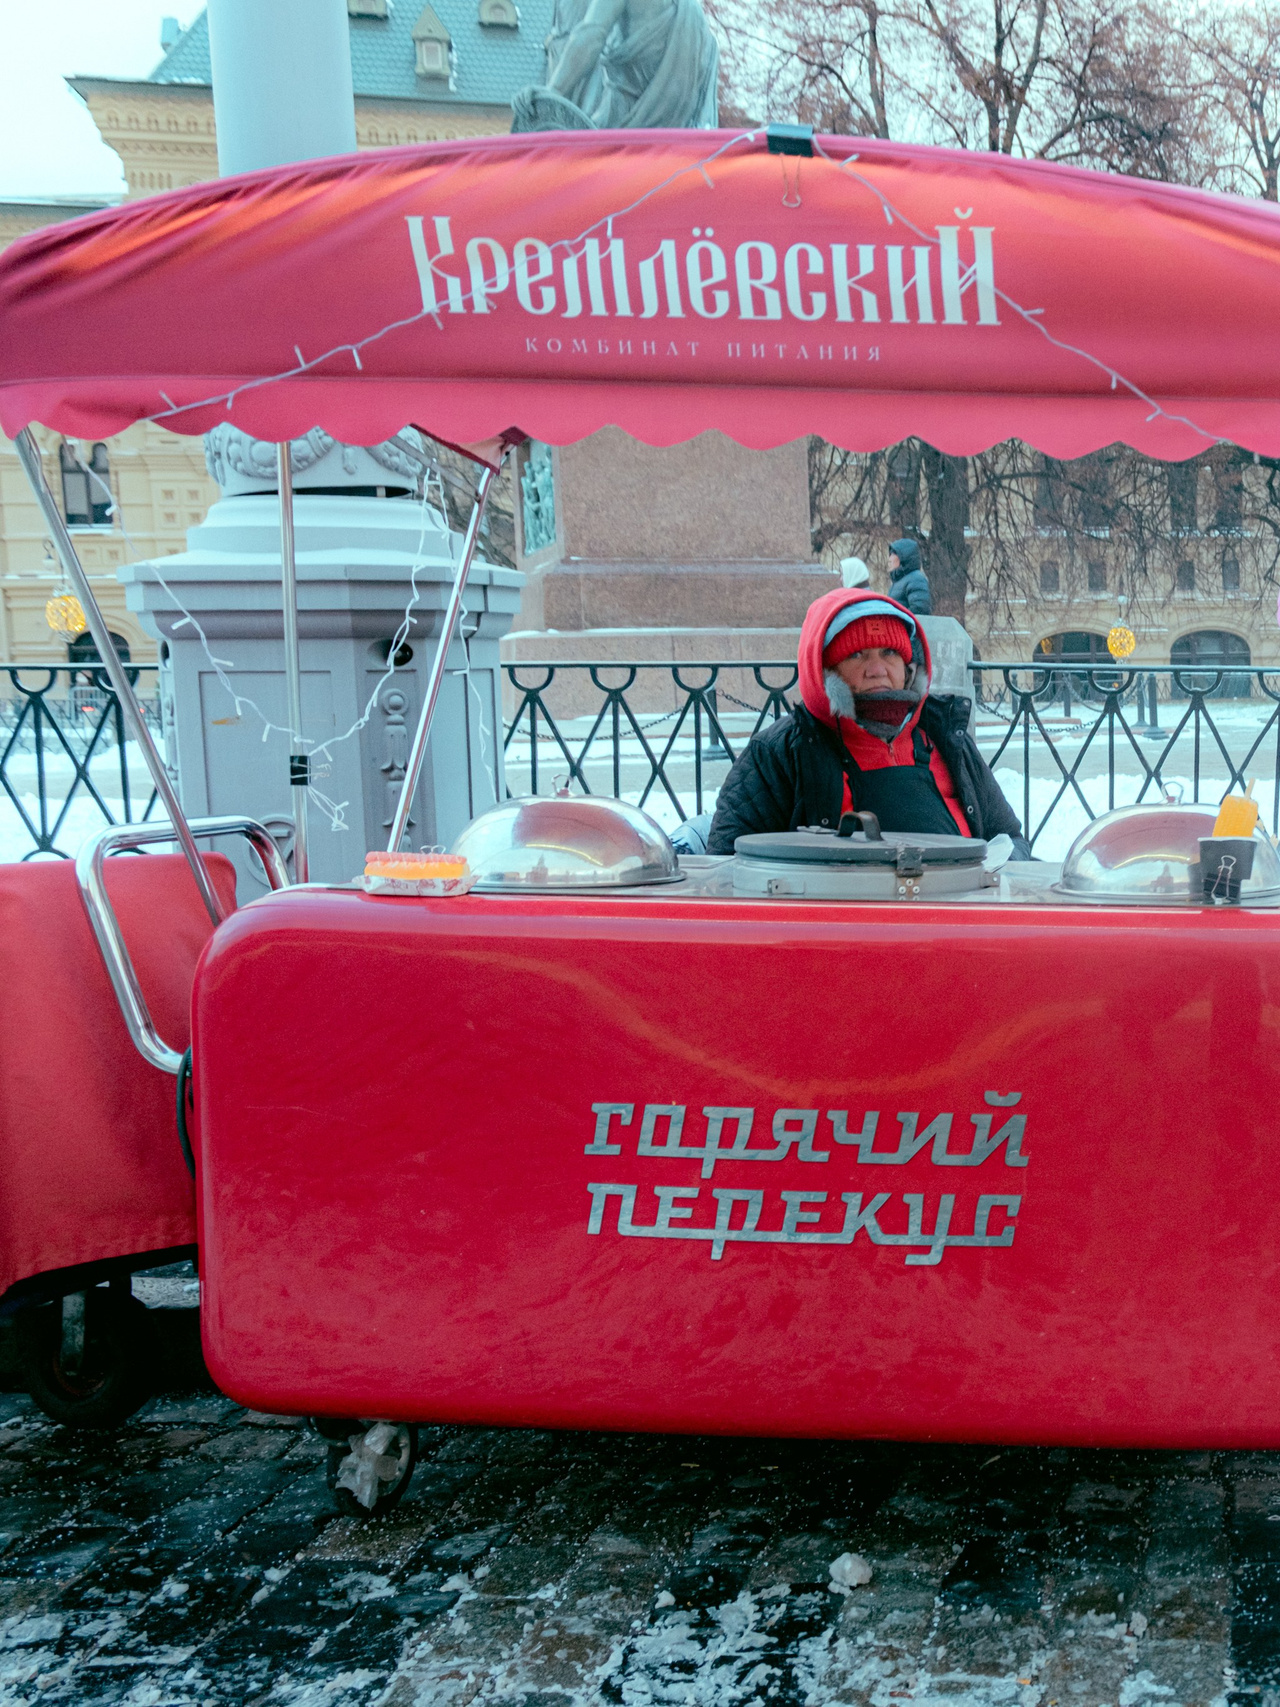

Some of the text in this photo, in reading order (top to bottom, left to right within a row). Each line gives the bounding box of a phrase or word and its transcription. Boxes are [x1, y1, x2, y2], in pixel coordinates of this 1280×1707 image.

[404, 207, 1001, 325] Кремлёвский
[525, 337, 881, 361] КОМБИНАТ ПИТАНИЯ
